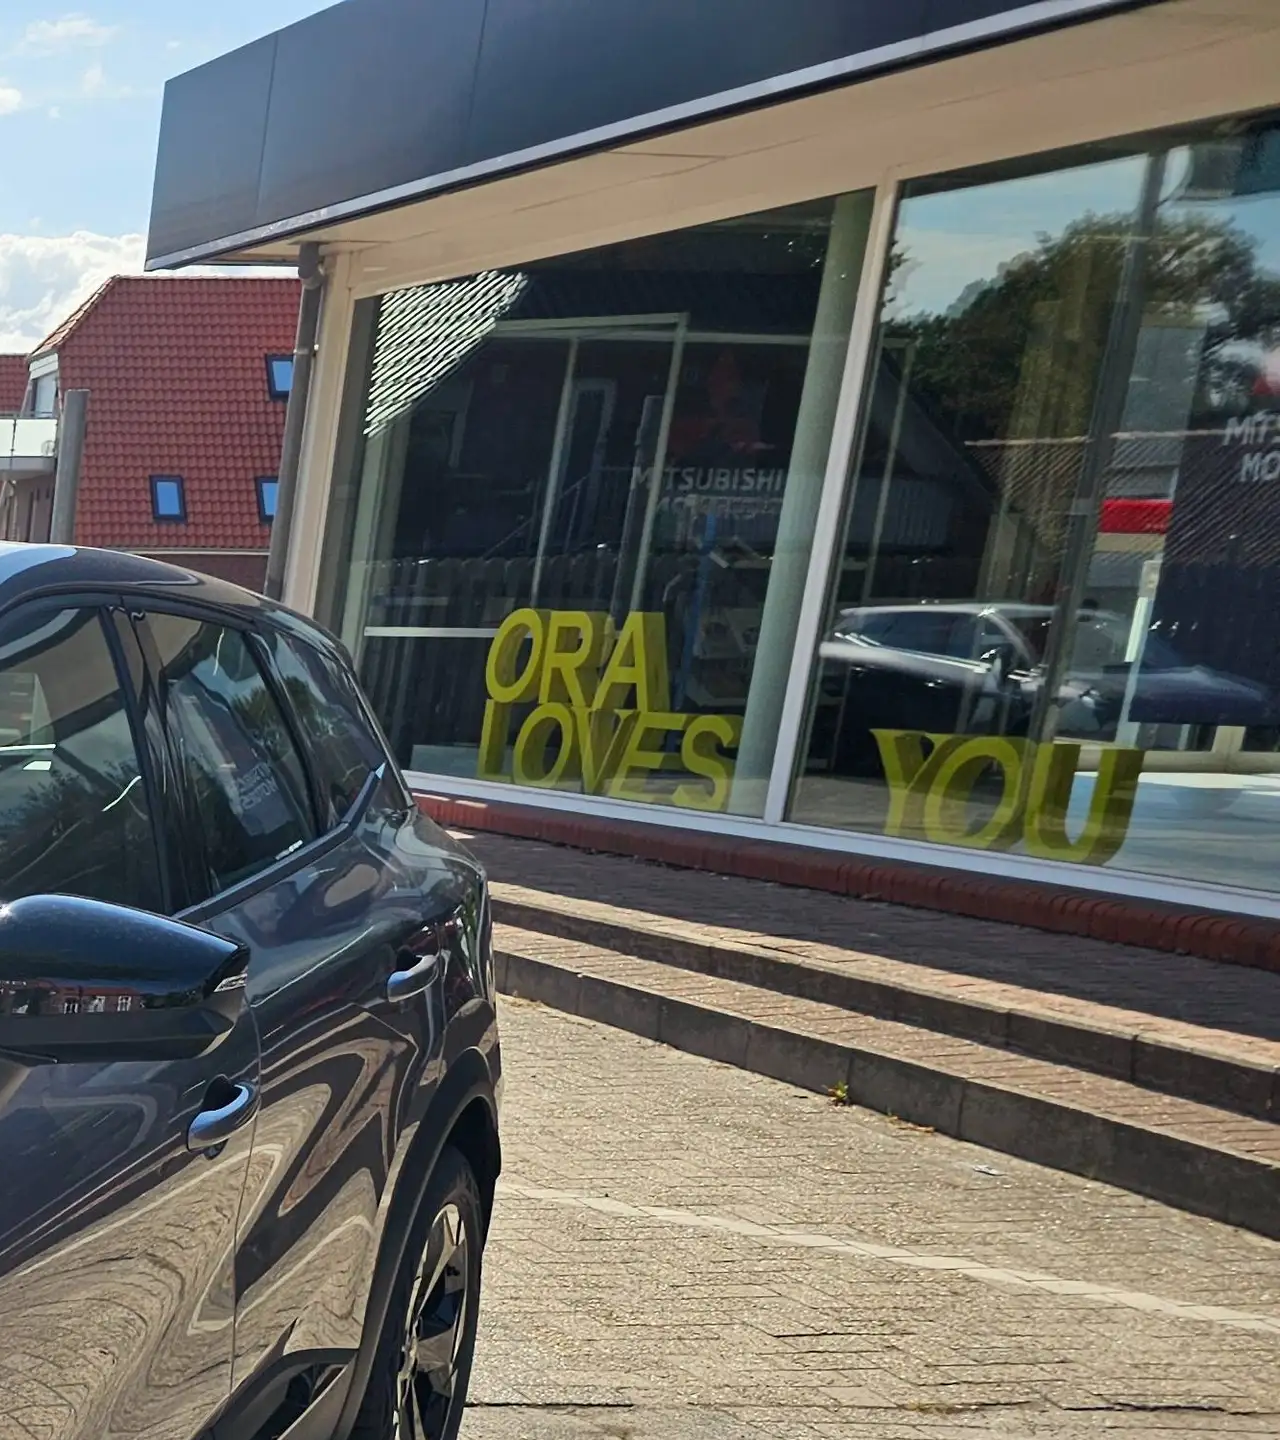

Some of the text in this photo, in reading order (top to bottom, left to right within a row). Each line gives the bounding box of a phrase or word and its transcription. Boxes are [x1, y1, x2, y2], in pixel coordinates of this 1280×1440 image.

[485, 607, 668, 714] ORA
[477, 699, 742, 812] LOVES
[869, 728, 1144, 865] YOU
